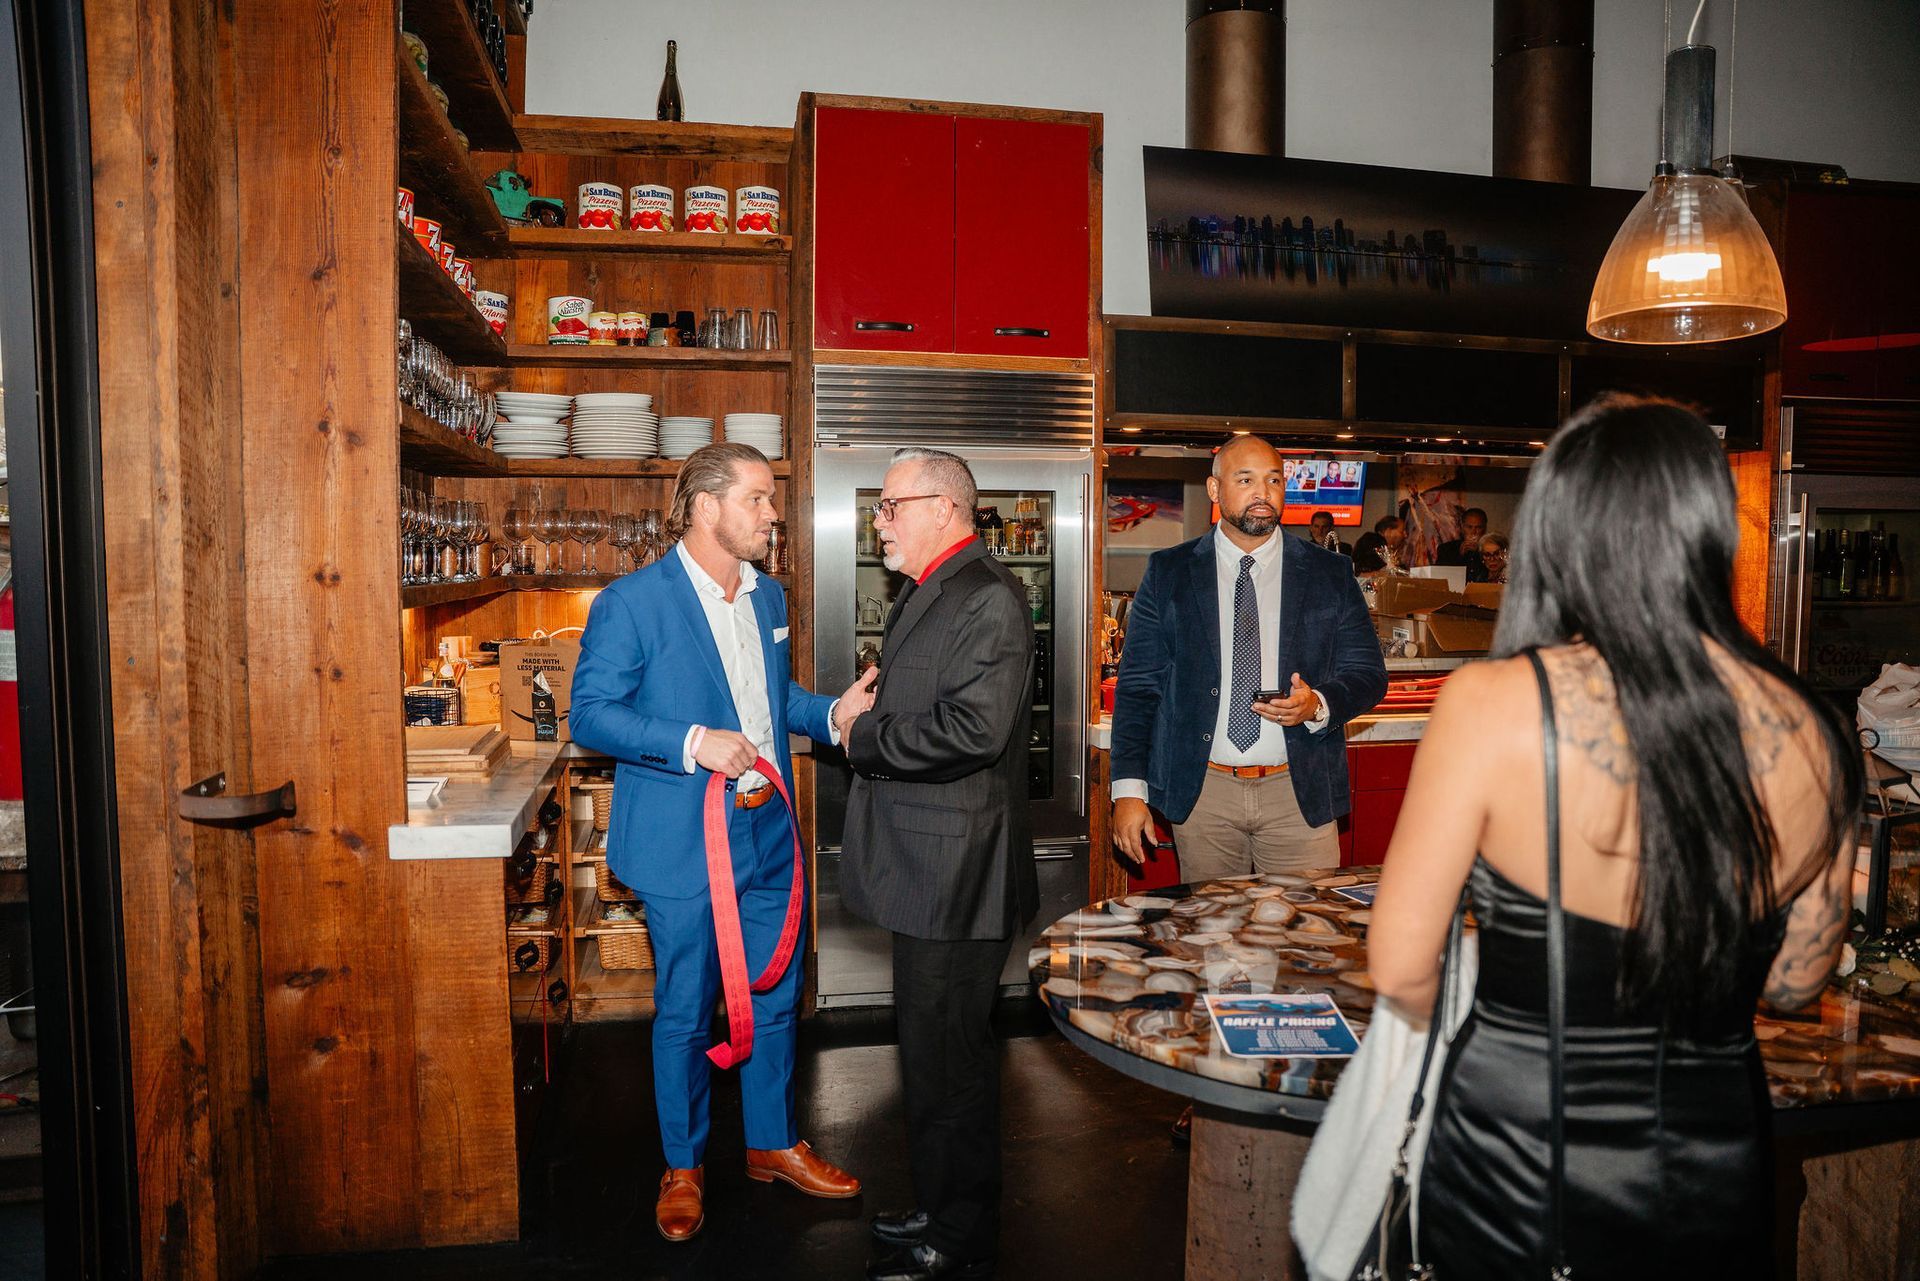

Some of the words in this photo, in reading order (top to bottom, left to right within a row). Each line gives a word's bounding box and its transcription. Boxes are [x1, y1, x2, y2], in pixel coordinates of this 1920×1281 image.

[589, 187, 602, 196] SAN
[637, 189, 650, 198] SAN
[692, 191, 704, 199] SAN
[747, 191, 760, 200] SAN
[588, 196, 619, 206] Pizzeria
[637, 198, 667, 207] Pizzeria
[690, 199, 721, 208] Pizzeria
[746, 199, 776, 209] Pizzeria
[542, 658, 560, 666] WITH
[1223, 1017, 1275, 1027] RAFFLE
[1278, 1017, 1337, 1027] PRICING
